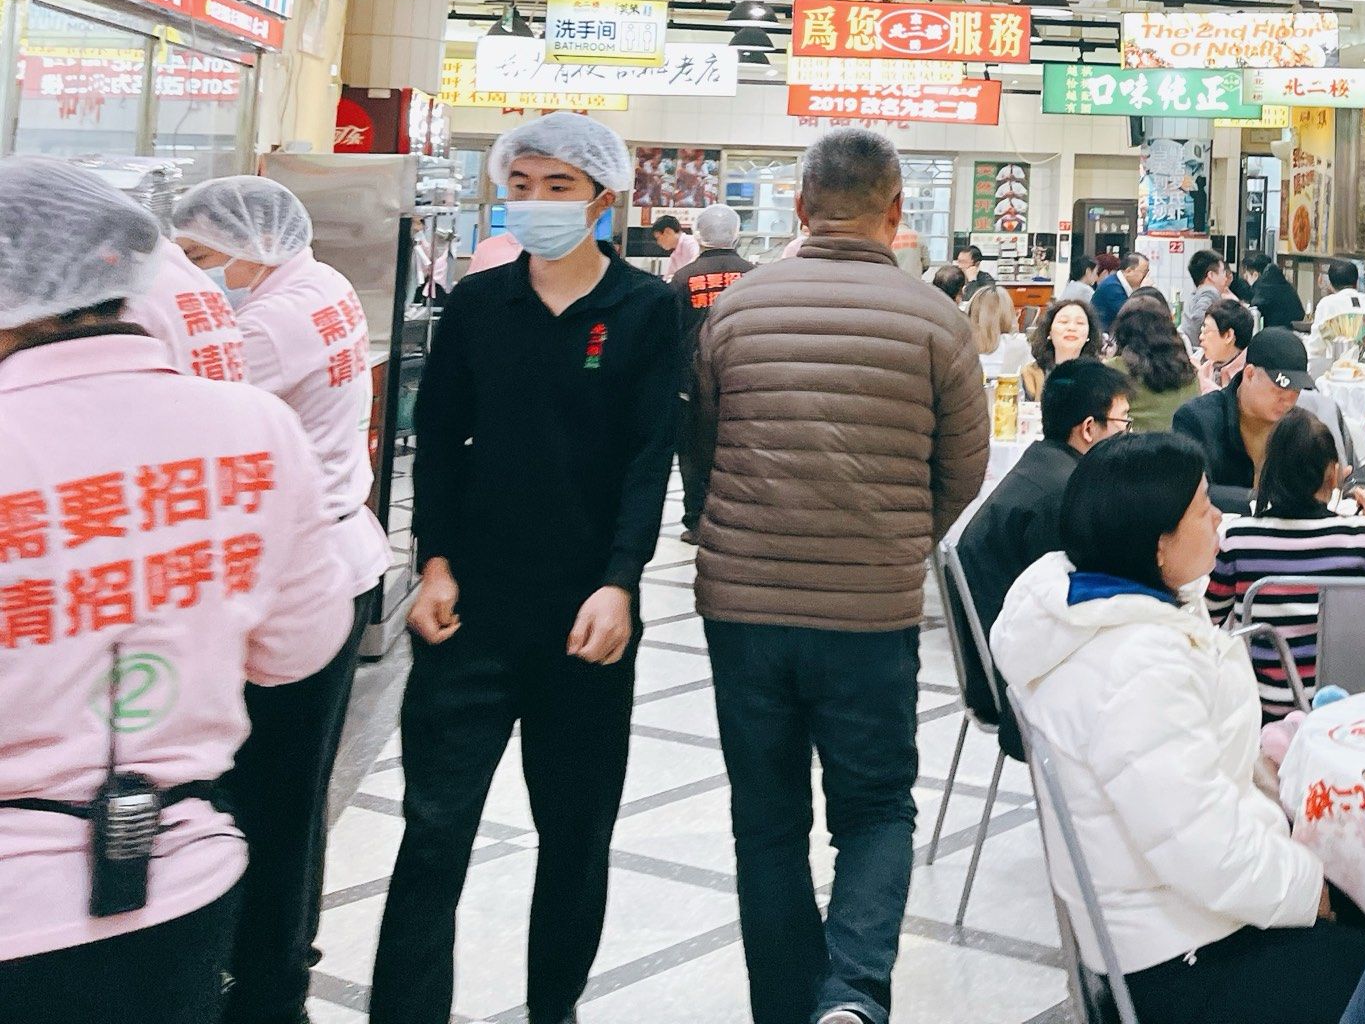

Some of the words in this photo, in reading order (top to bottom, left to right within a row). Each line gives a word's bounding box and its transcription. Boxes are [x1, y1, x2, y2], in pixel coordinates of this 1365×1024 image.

[555, 19, 616, 41] 洗手间
[1142, 23, 1189, 39] The
[1196, 23, 1247, 39] 2nd
[555, 41, 615, 52] BATHROOM
[1282, 78, 1350, 99] 北二楼
[808, 96, 859, 111] 2019
[0, 450, 277, 564] 需要招呼
